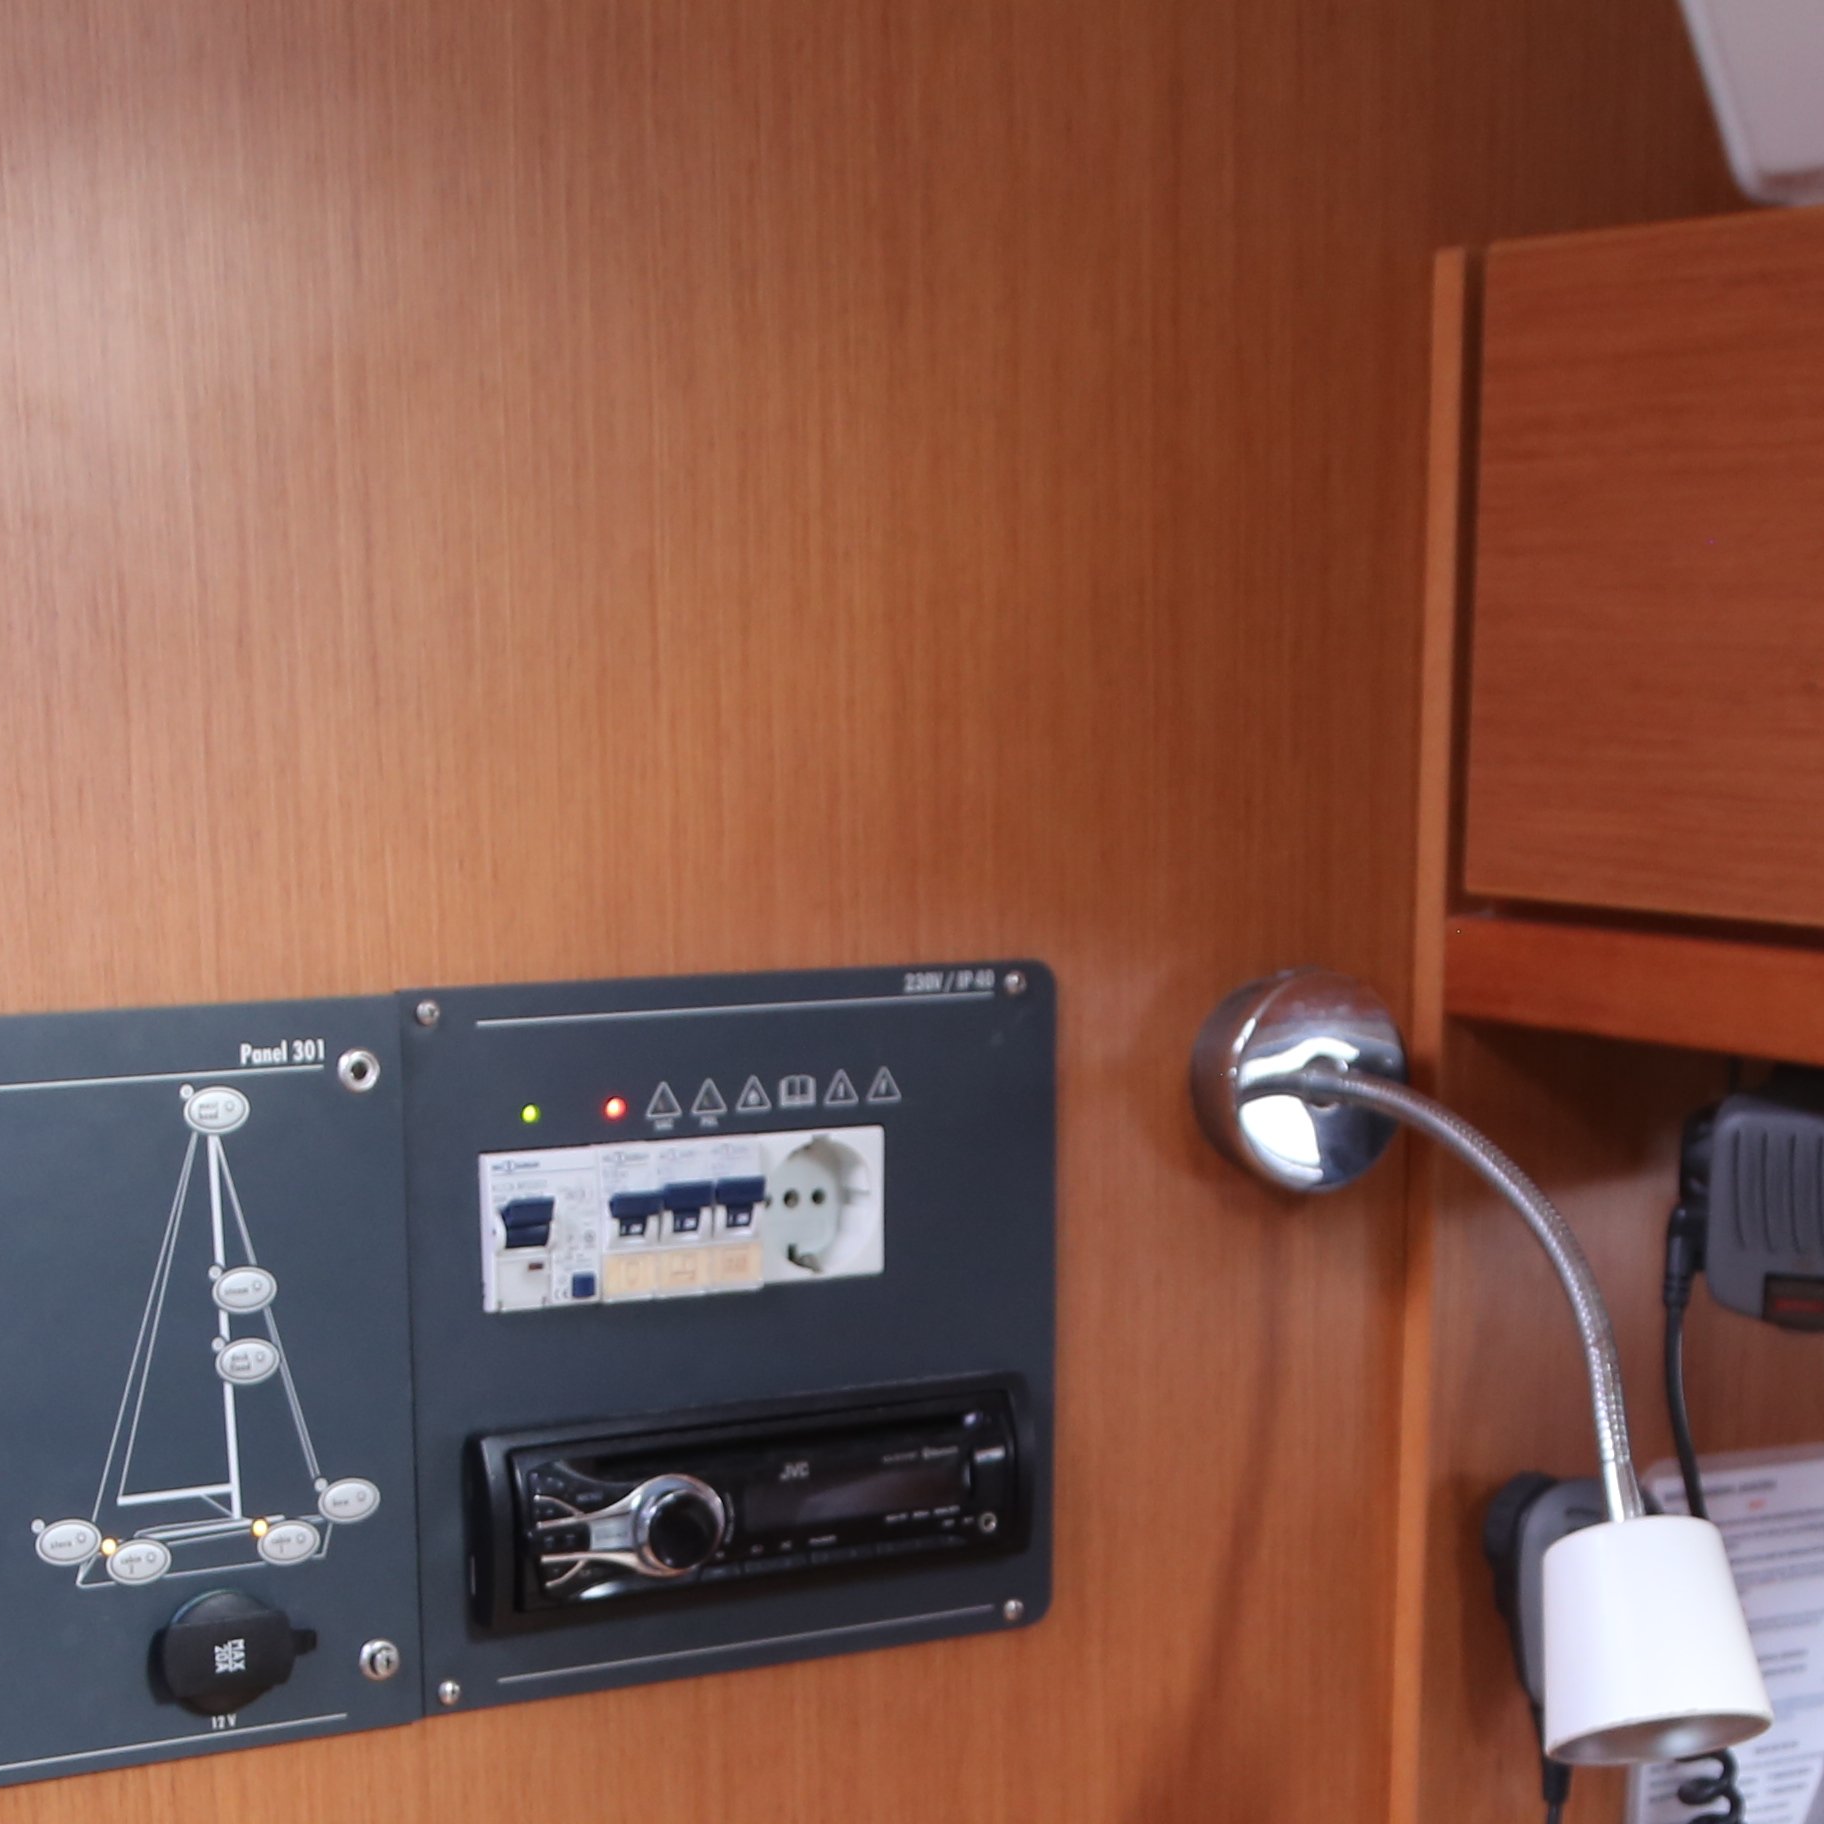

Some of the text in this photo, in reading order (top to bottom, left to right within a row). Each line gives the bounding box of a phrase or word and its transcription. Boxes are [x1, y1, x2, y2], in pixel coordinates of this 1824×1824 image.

[239, 1038, 325, 1066] Panel 301
[780, 1461, 809, 1482] JVC
[214, 1645, 229, 1674] 20A
[227, 1639, 246, 1672] MAX
